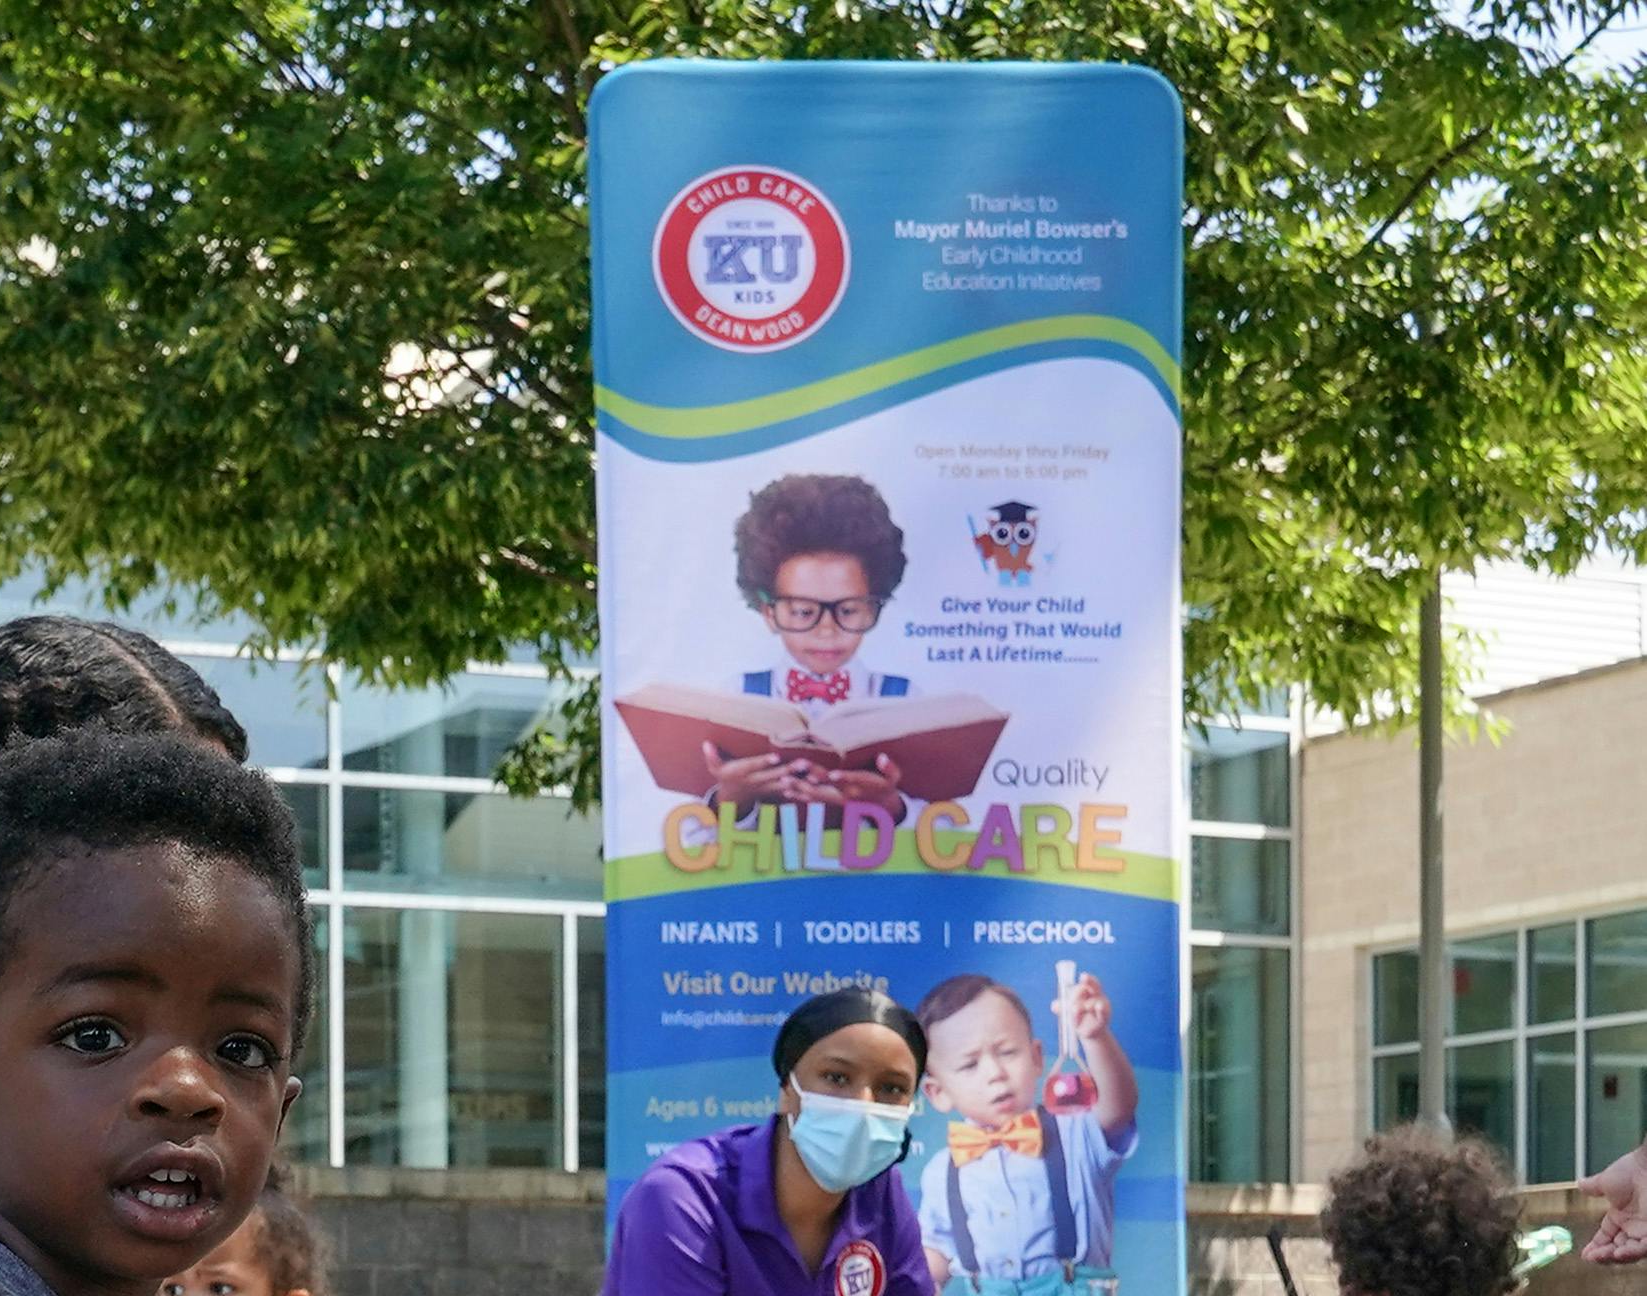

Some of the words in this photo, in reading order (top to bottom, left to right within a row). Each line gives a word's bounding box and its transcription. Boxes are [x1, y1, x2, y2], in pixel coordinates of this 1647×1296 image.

[686, 176, 750, 214] CHILD
[759, 178, 816, 215] CARE
[967, 193, 1035, 213] Thanks
[1039, 194, 1058, 213] to
[895, 220, 960, 242] Mayor
[965, 219, 1031, 239] Muriel
[1035, 219, 1128, 240] Bowser's
[704, 235, 802, 285] KU
[941, 246, 988, 269] Early
[990, 246, 1083, 265] Childhood
[922, 271, 1014, 291] Education
[1017, 272, 1102, 291] Initiatives
[734, 290, 776, 304] KIDS
[695, 304, 806, 342] DEANWOOD
[915, 444, 954, 460] Open
[960, 444, 1022, 461] Monday
[1061, 444, 1112, 462] Friday
[976, 467, 1000, 479] am
[1062, 467, 1088, 481] pm
[941, 598, 982, 614] Give
[986, 598, 1032, 614] Your
[1036, 597, 1085, 614] Child
[905, 622, 1008, 641] Something
[1014, 622, 1056, 639] That
[1061, 622, 1122, 639] Would
[927, 647, 966, 663] Last
[970, 647, 983, 662] A
[992, 759, 1110, 791] Quality
[662, 801, 896, 873] CHILD
[915, 802, 1130, 873] CARE
[661, 920, 759, 945] INFANTS
[804, 920, 922, 945] TODDLERS
[973, 920, 1116, 945] PRESCHOOL
[663, 970, 723, 995] Visit
[730, 970, 777, 995] Our
[645, 1096, 700, 1122] Ages
[705, 1096, 718, 1118] 6
